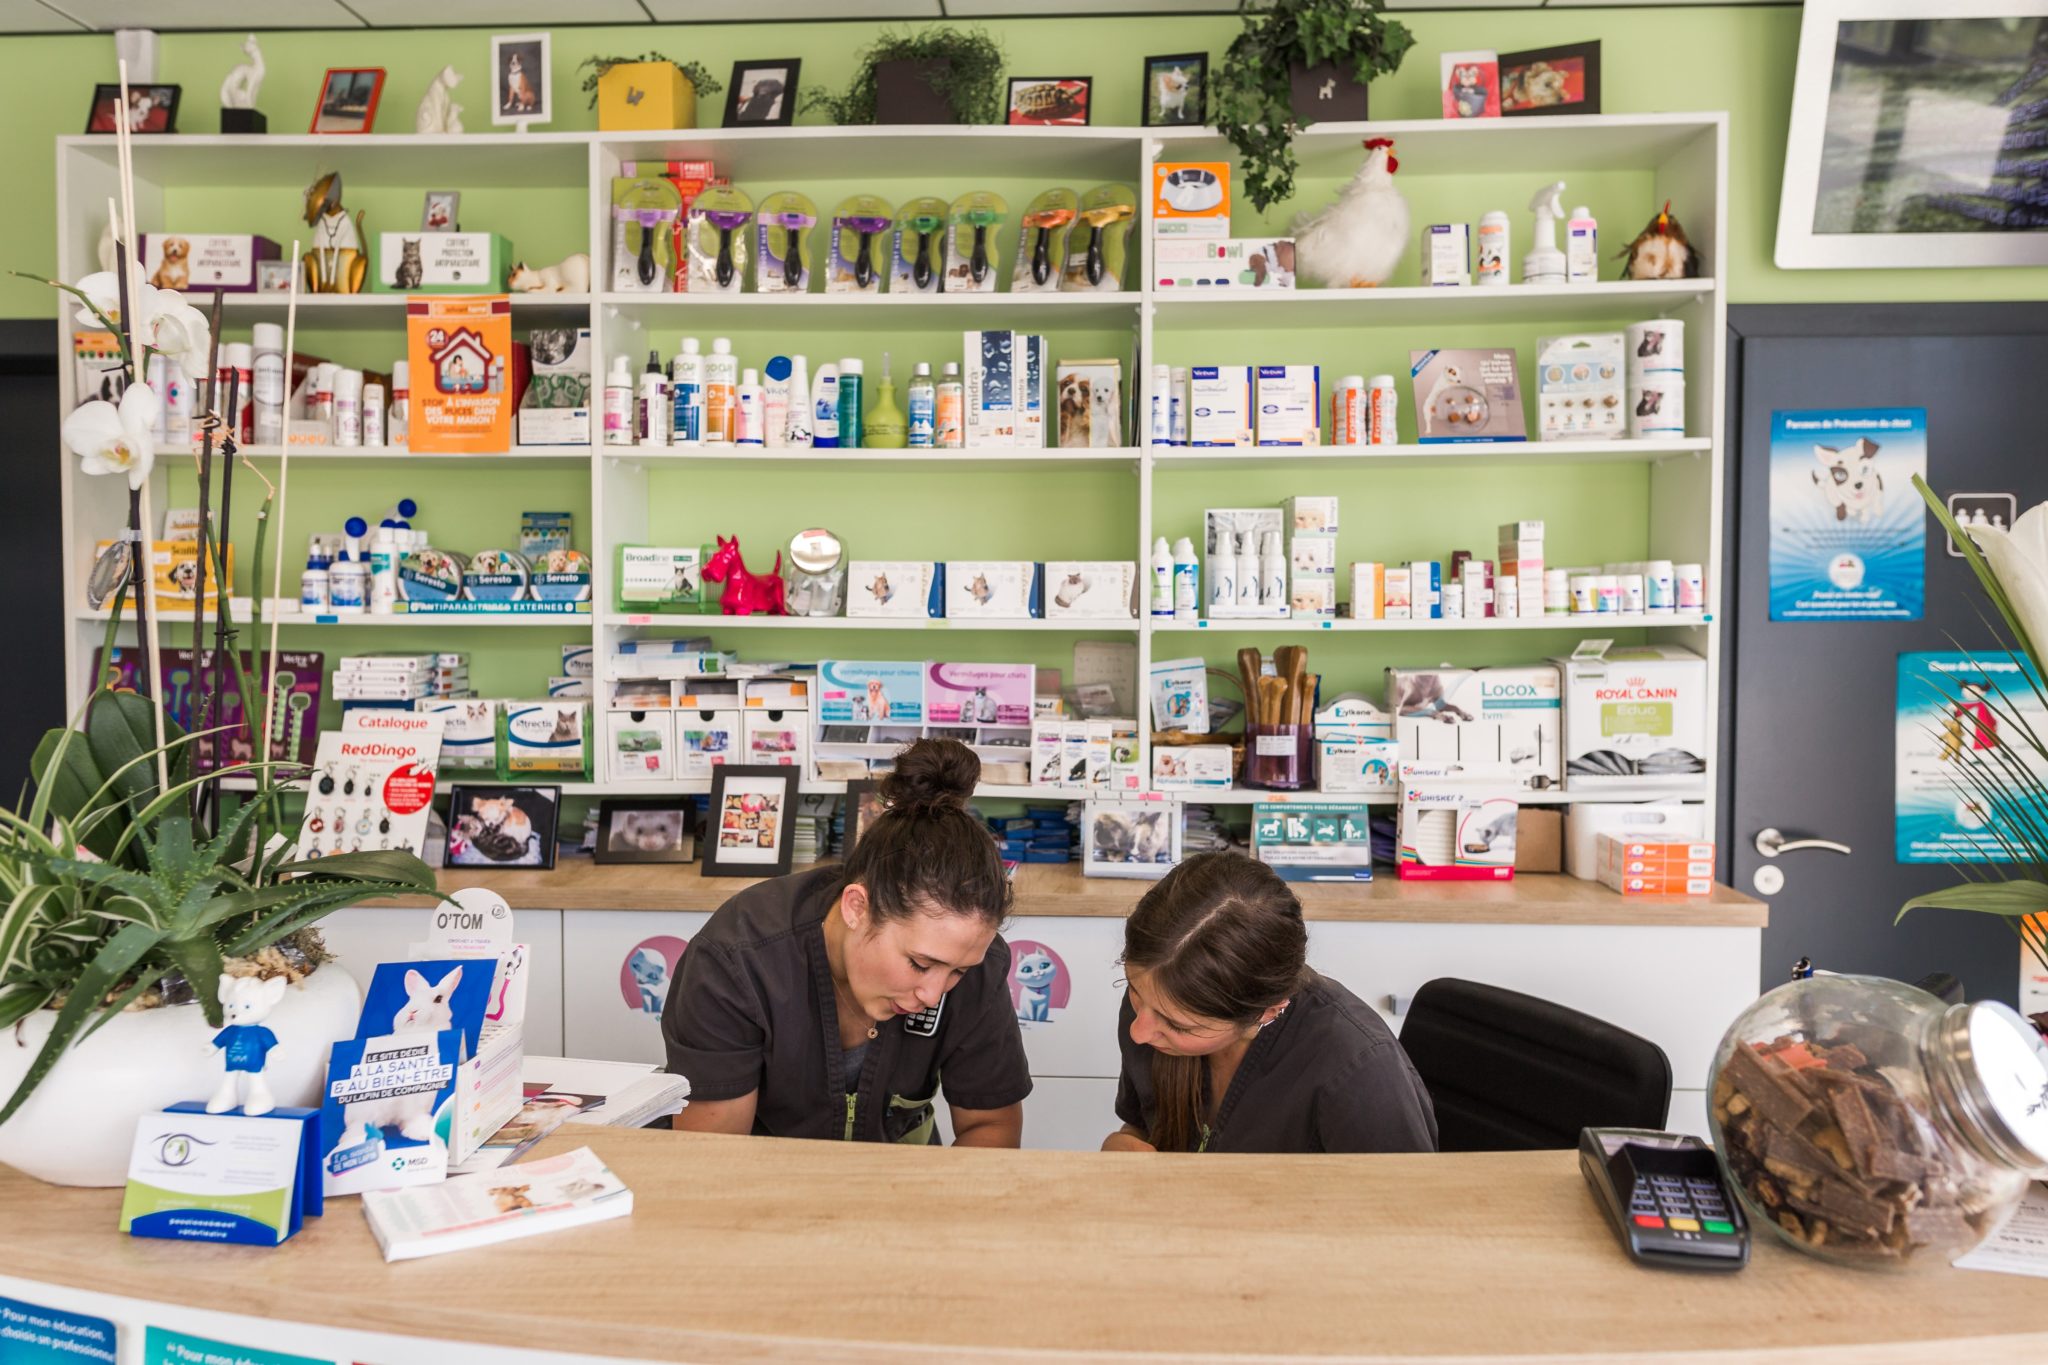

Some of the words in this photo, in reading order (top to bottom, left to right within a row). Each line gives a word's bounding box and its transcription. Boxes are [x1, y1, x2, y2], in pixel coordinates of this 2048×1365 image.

[1193, 369, 1217, 377] Virbac
[1260, 368, 1284, 376] Virbac
[625, 553, 670, 562] Broadline
[414, 573, 446, 589] Seresto
[479, 576, 512, 584] Seresto
[546, 574, 579, 582] Seresto
[513, 603, 563, 611] EXTERNES
[1596, 689, 1633, 700] ROYAL
[1637, 688, 1677, 699] CANIN
[1617, 704, 1657, 716] Educ
[358, 716, 428, 730] Catalogue
[341, 743, 416, 759] RedDingo
[437, 913, 483, 929] O'TOM
[367, 1053, 378, 1062] LE
[380, 1050, 399, 1061] SITE
[368, 1065, 383, 1076] LA
[334, 1082, 344, 1094] &
[348, 1080, 369, 1092] AU
[338, 1094, 352, 1104] DU
[353, 1091, 380, 1103] LAPIN
[381, 1089, 394, 1099] DE
[394, 1081, 448, 1098] COMPAGNIE
[407, 1157, 428, 1166] MSD
[3, 1307, 27, 1323] Pour
[29, 1315, 51, 1328] mon
[176, 1344, 204, 1363] Pour
